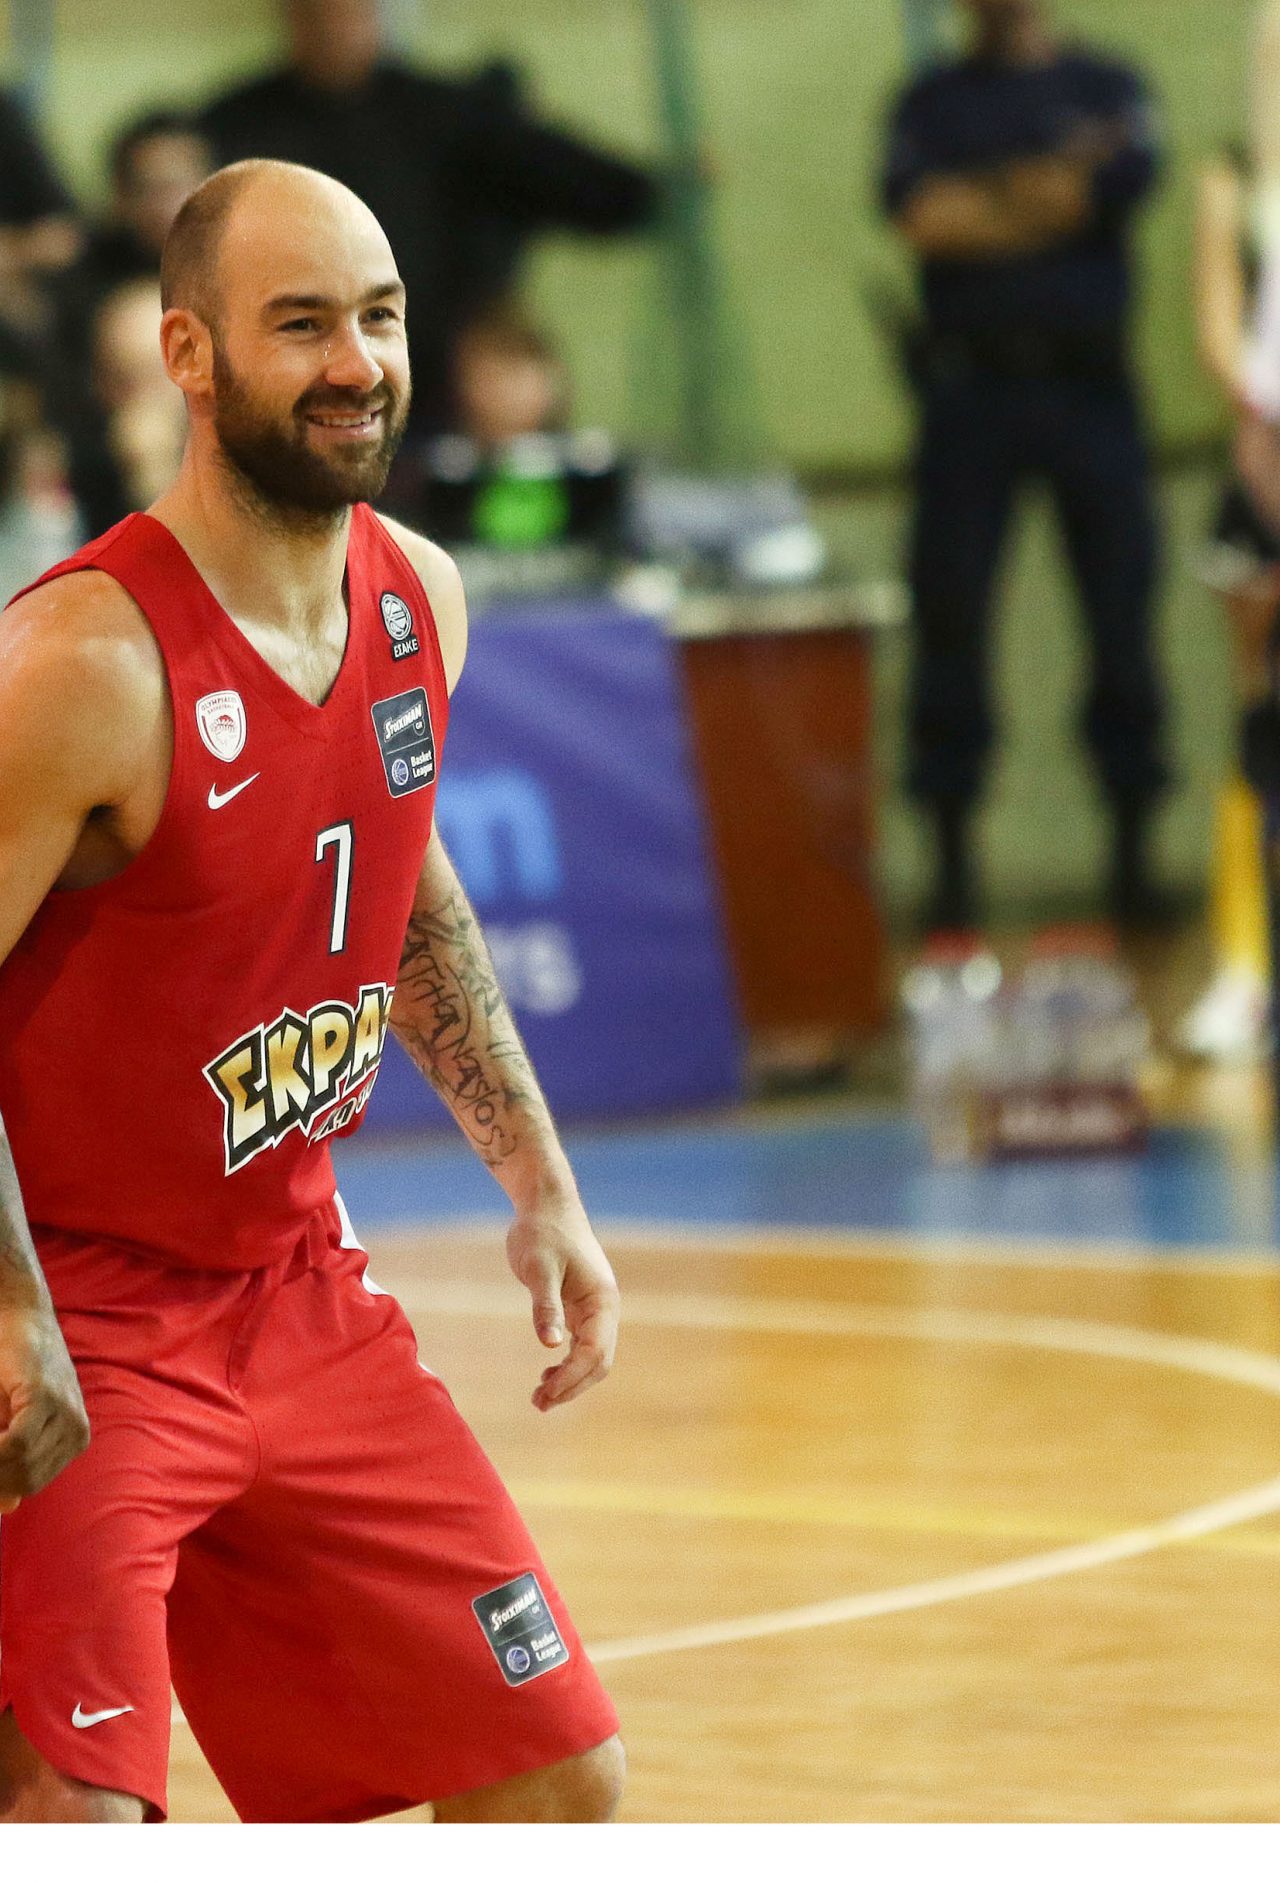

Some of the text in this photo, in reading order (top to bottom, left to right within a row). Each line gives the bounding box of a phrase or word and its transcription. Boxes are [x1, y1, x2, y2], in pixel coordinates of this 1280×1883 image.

[393, 638, 419, 658] ΕΣΑΚΕ
[410, 749, 432, 768] Basket
[412, 762, 433, 779] League
[314, 820, 354, 955] 7
